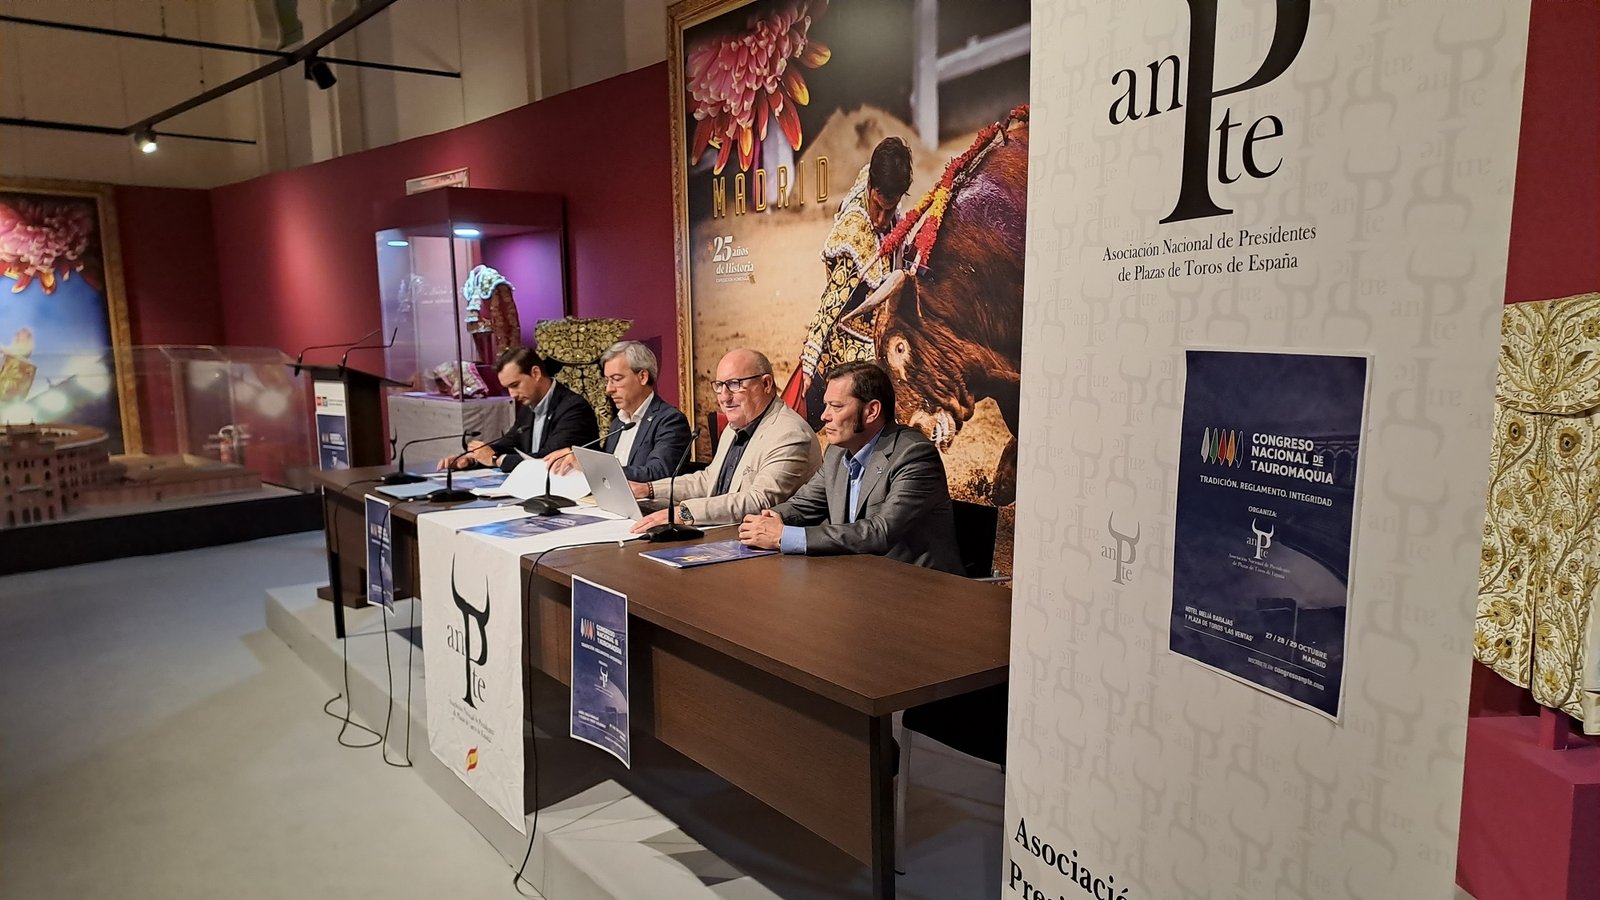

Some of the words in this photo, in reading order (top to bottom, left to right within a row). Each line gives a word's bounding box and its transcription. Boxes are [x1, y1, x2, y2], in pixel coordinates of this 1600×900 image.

[712, 155, 829, 218] MADRID
[712, 235, 733, 262] 25
[1102, 243, 1159, 262] Asociación
[1162, 233, 1213, 255] Nacional
[1217, 232, 1234, 249] de
[1238, 225, 1317, 247] Presidentes
[716, 264, 724, 274] de
[1118, 266, 1131, 282] de
[1134, 265, 1165, 281] Plazas
[1168, 262, 1181, 277] de
[1184, 259, 1223, 276] Toros
[1226, 255, 1244, 273] de
[1248, 252, 1298, 272] España
[1252, 433, 1314, 452] CONGRESO
[1251, 445, 1309, 465] NACIONAL
[1312, 454, 1324, 467] DE
[1250, 460, 1334, 485] TAUROMAQUIA
[1240, 482, 1288, 498] REGLAMENTO.
[1289, 490, 1333, 507] INTEGRIDAD
[1265, 631, 1272, 640] 27
[1289, 640, 1297, 649] 29
[1298, 643, 1328, 660] OCTUBRE
[1302, 654, 1327, 669] MADRID
